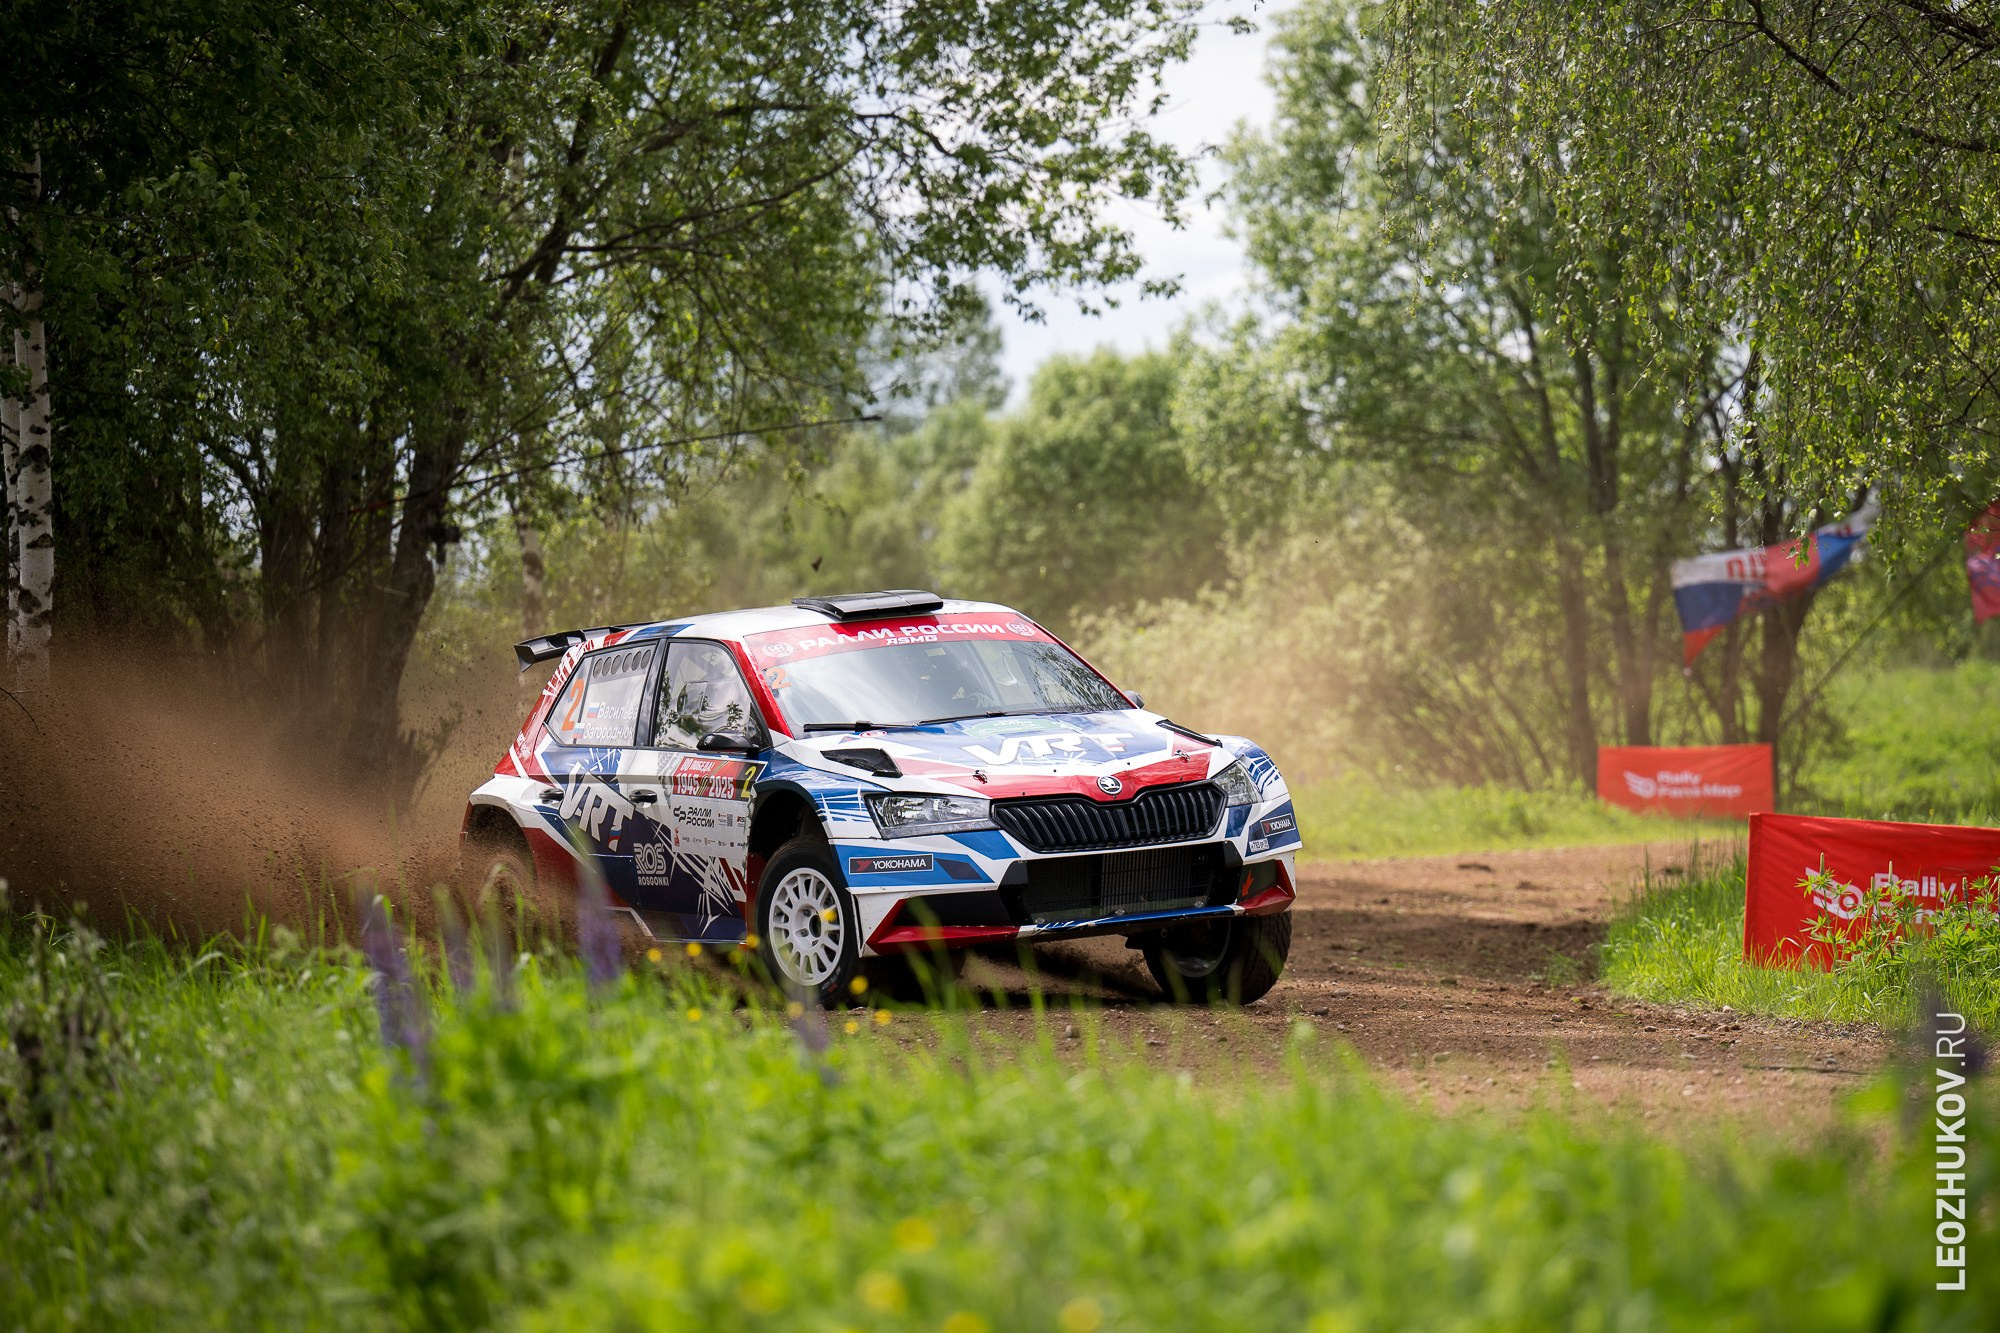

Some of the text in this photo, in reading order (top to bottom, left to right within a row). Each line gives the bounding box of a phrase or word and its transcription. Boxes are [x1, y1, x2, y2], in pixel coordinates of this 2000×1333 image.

[799, 623, 1006, 651] РАЛЛИ РОССИИ
[766, 667, 792, 690] 2
[562, 678, 585, 731] 2
[961, 732, 1137, 766] VRT
[676, 772, 734, 799] 1945 2025
[740, 765, 757, 798] 2
[559, 761, 637, 853] VRT
[687, 806, 712, 818] РАЛЛИ
[686, 817, 715, 828] РОССИИ
[1270, 819, 1291, 830] YOKOHAMA
[633, 842, 667, 875] ROS
[872, 858, 927, 869] YOKOHAMA
[638, 876, 669, 886] ROSGONKI
[1873, 872, 1957, 903] Rally
